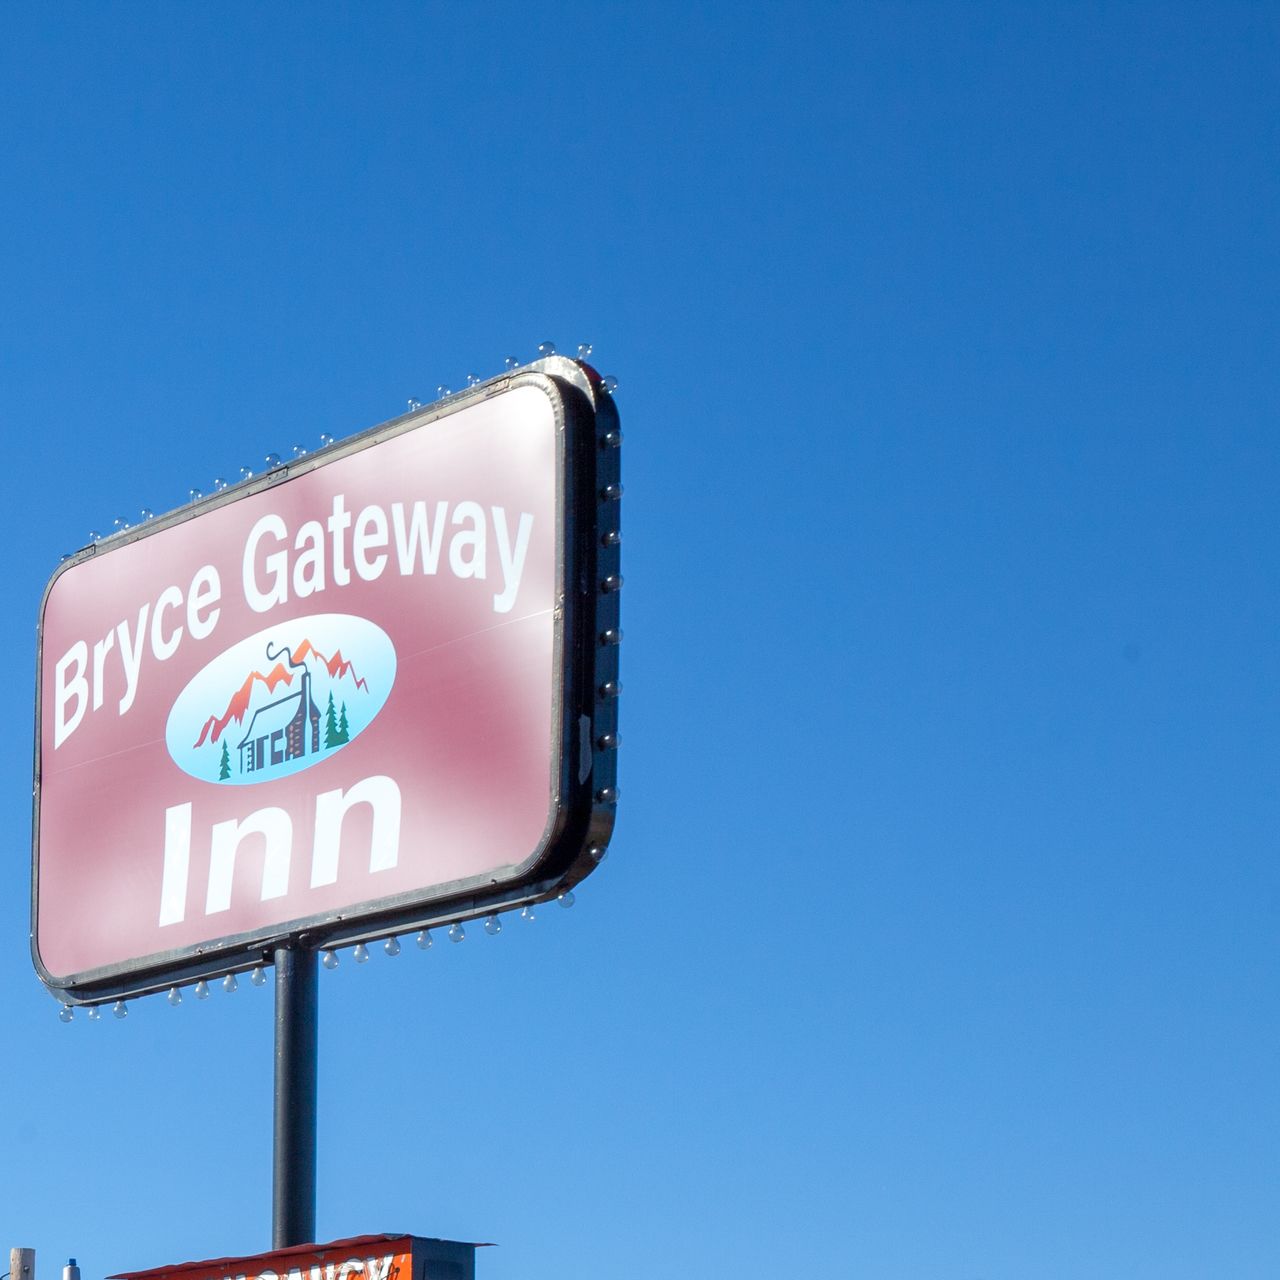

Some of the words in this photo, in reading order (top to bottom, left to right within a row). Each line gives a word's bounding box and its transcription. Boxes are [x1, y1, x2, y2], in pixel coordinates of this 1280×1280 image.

[53, 563, 221, 751] Bryce
[242, 494, 535, 614] Gateway
[158, 774, 403, 928] Inn
